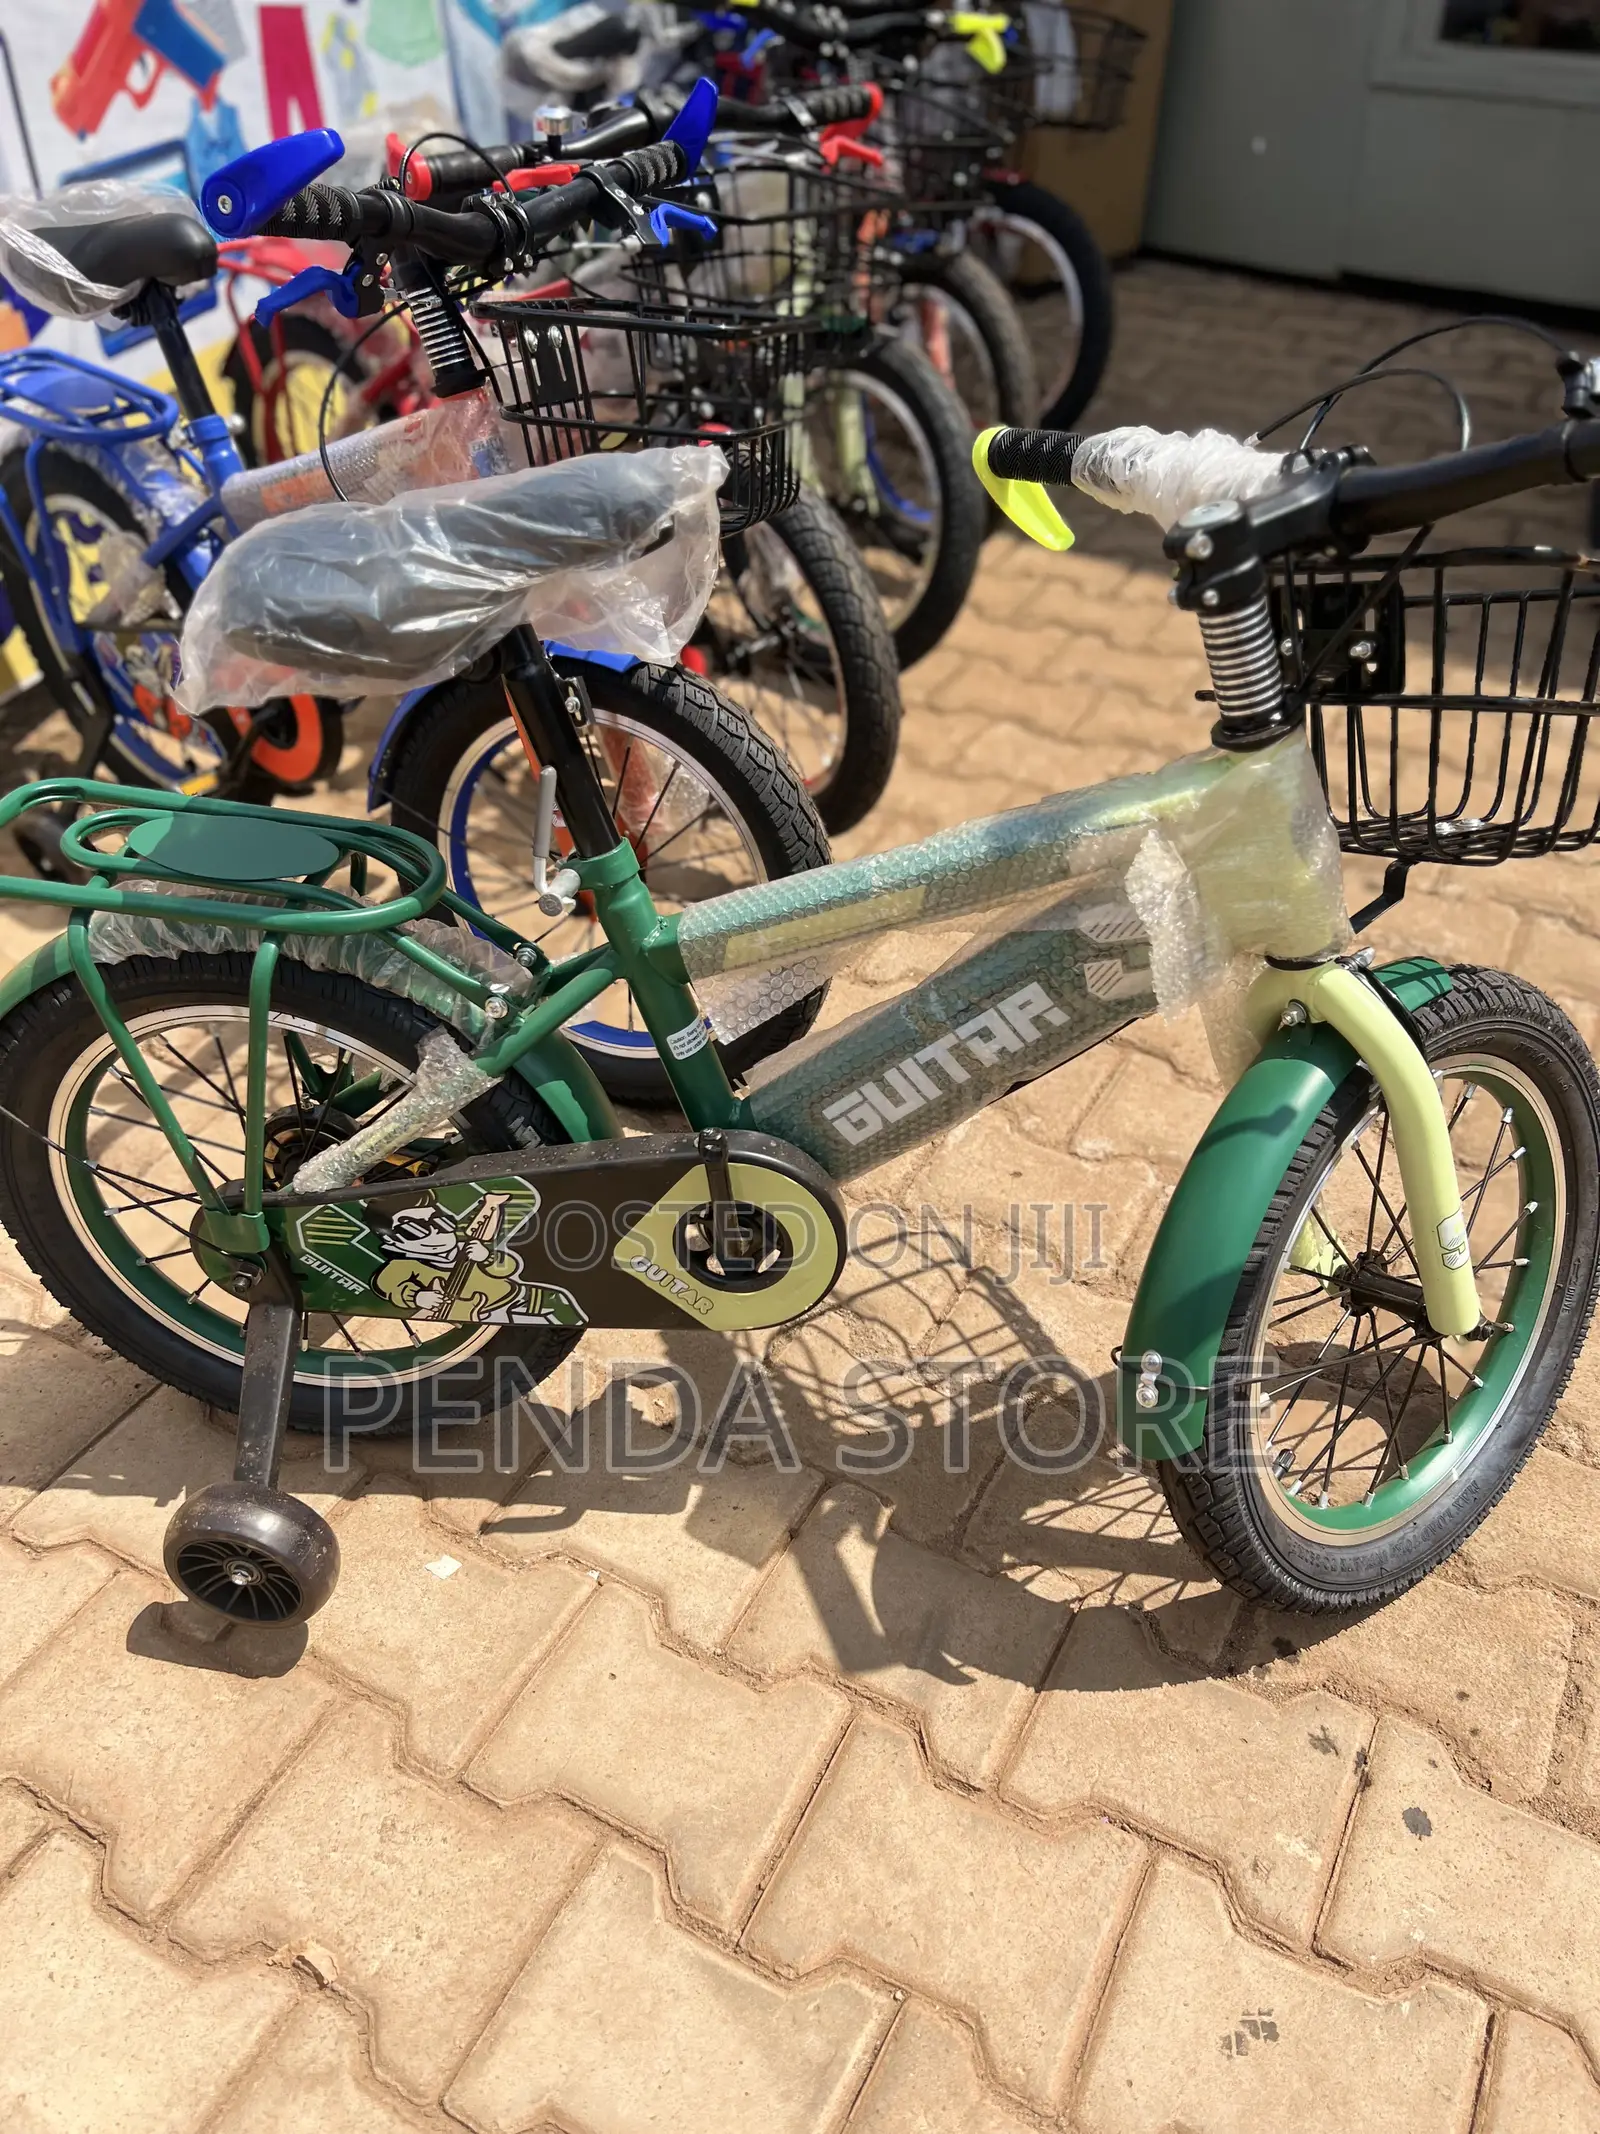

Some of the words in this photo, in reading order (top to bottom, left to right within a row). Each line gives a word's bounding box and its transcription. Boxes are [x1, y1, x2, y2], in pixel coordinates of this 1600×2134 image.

[822, 981, 1070, 1145] GUITAR
[300, 1254, 366, 1295] GUITAR
[630, 1255, 714, 1315] GUITAR
